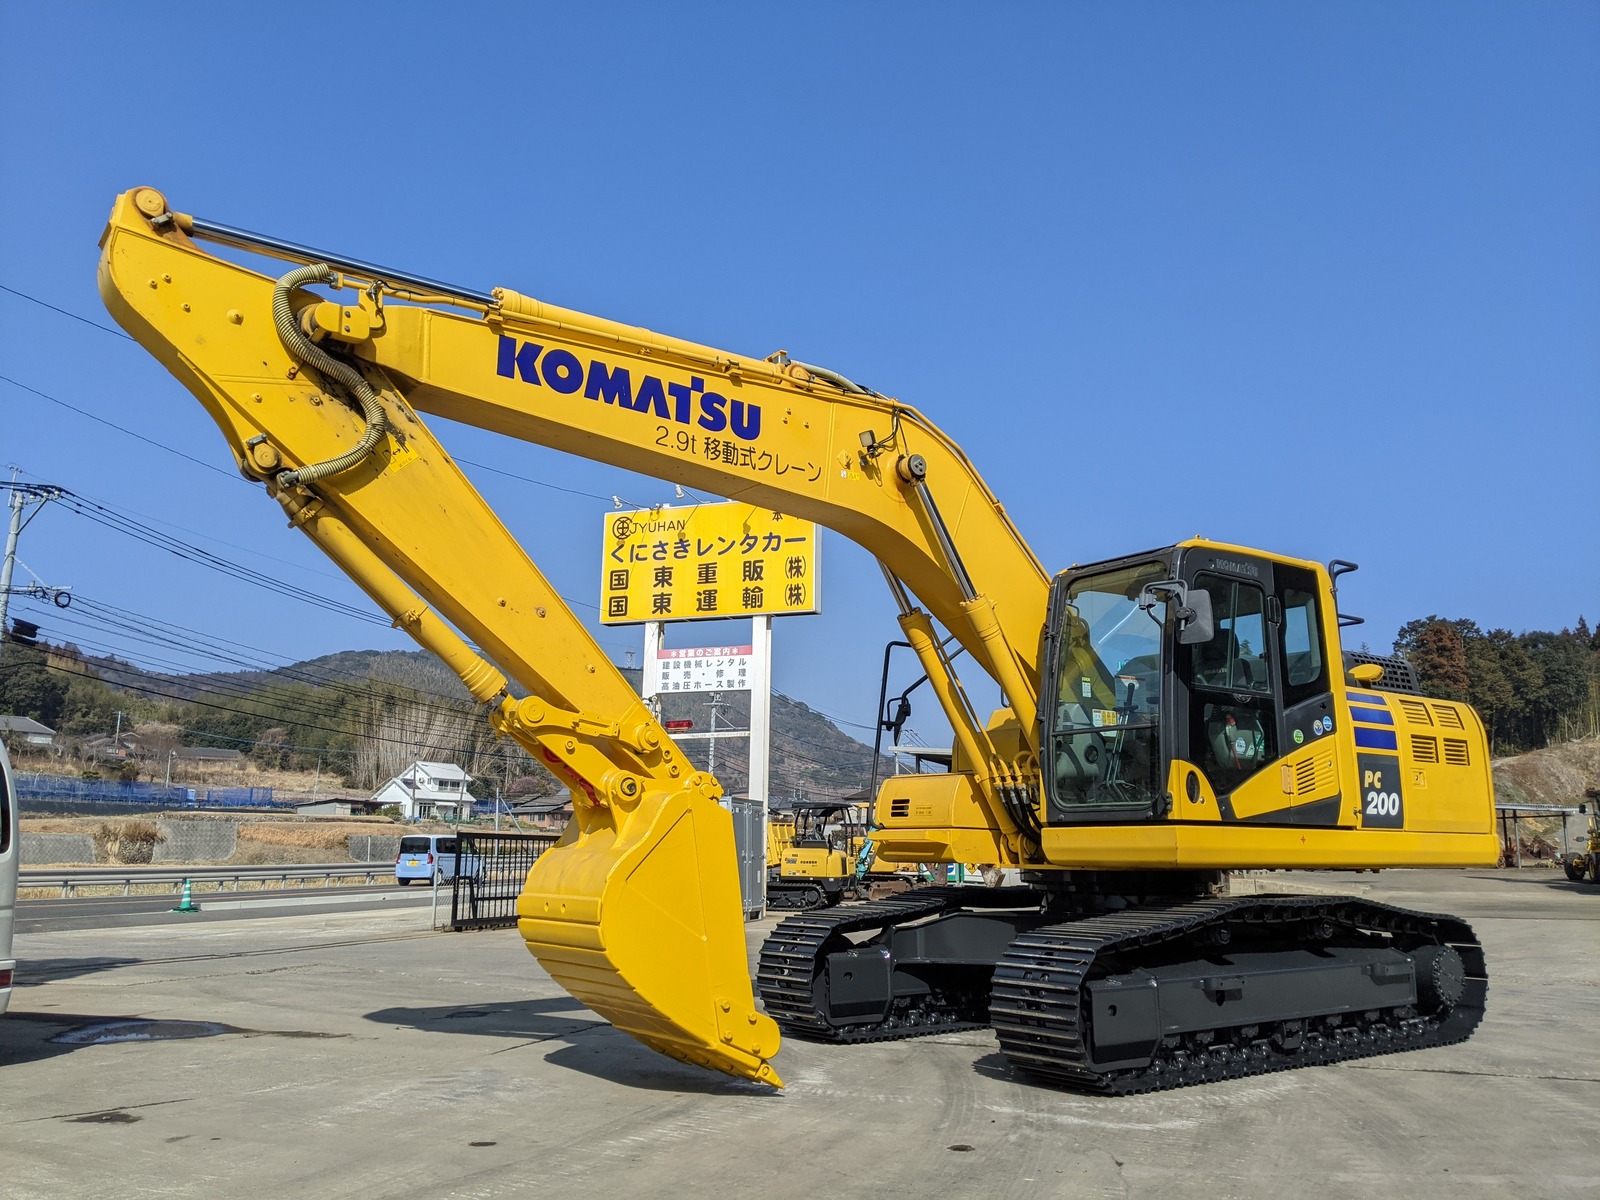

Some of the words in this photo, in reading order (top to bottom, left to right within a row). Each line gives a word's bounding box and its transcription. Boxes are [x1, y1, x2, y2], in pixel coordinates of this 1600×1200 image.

[497, 335, 761, 440] KOMATSU
[655, 425, 697, 454] 2.9t
[703, 436, 822, 482] 移動式クレーン
[611, 532, 806, 563] くにさきレンタカー
[662, 658, 747, 670] 建設機械レンタル
[661, 680, 747, 691] 高油圧ホース製作
[1364, 770, 1382, 789] PC
[1366, 791, 1399, 816] 200
